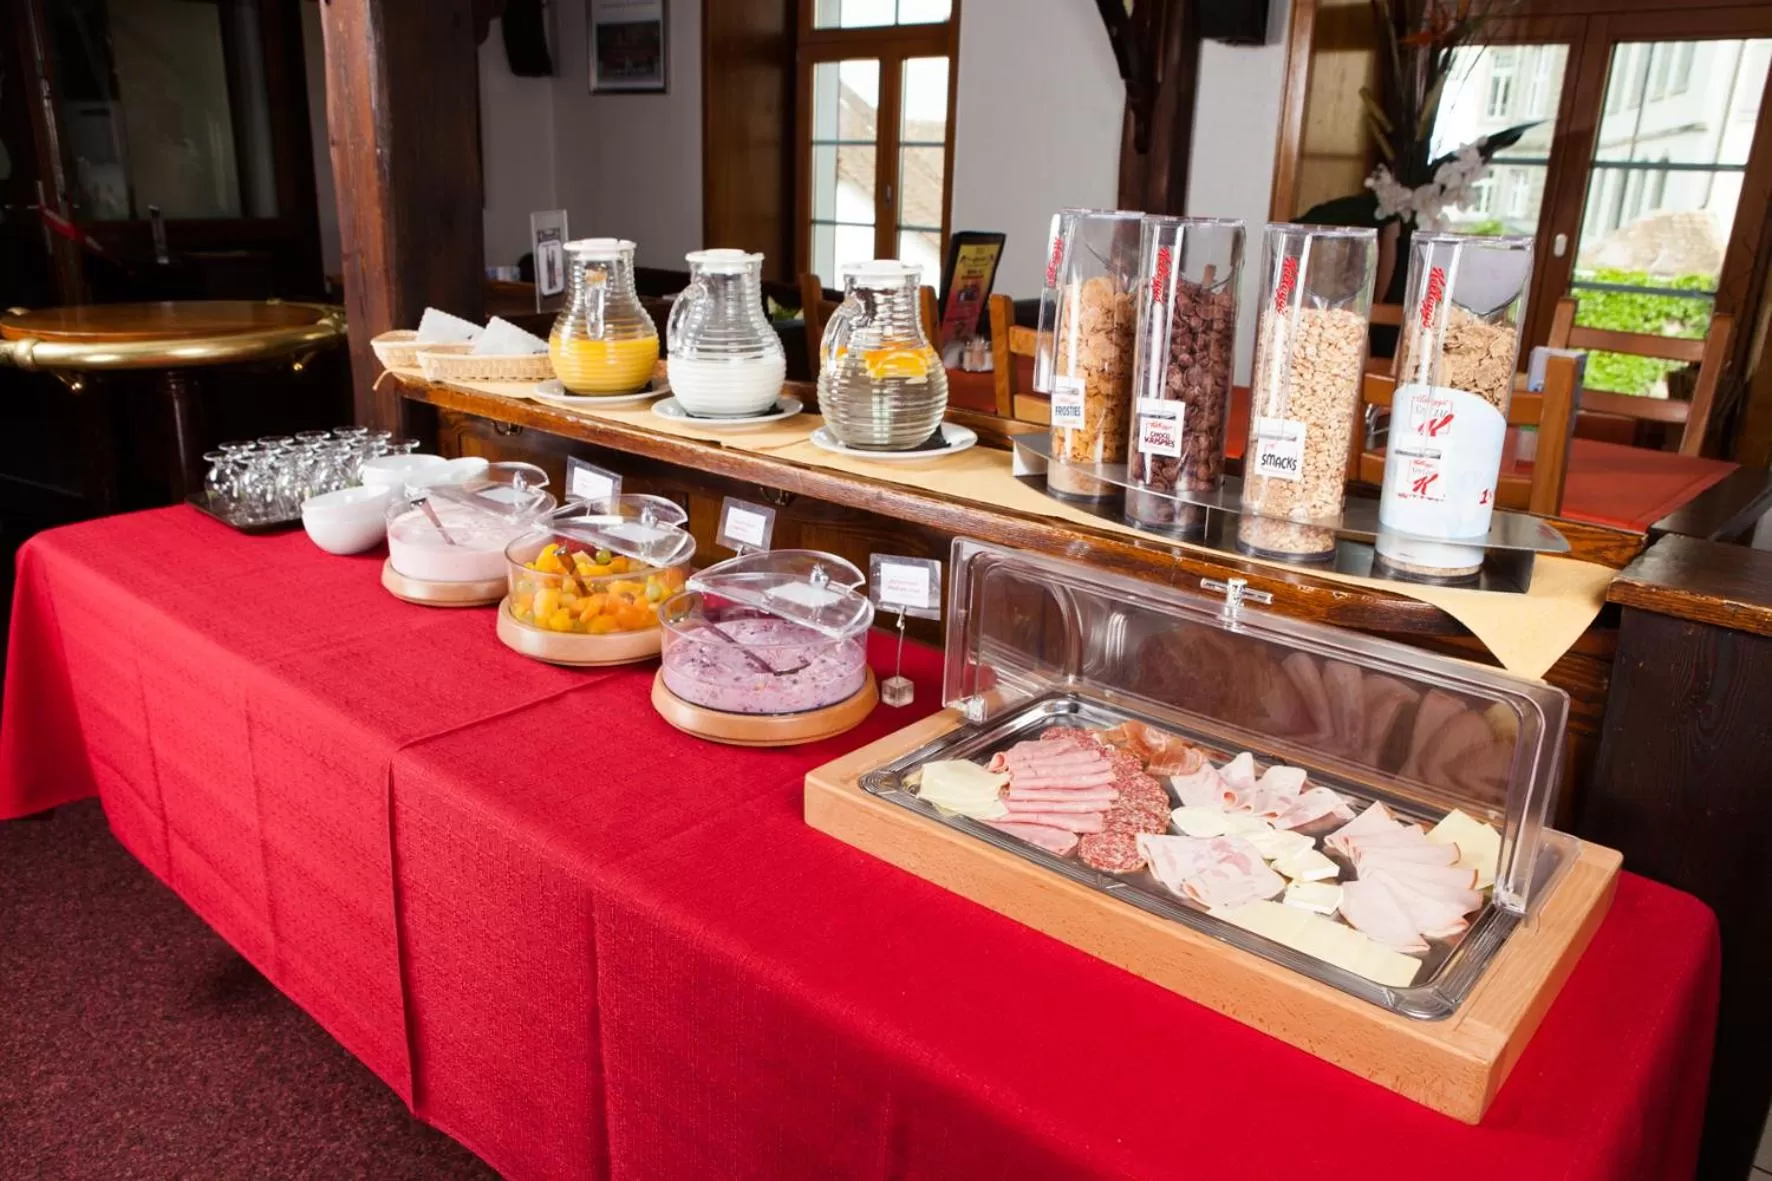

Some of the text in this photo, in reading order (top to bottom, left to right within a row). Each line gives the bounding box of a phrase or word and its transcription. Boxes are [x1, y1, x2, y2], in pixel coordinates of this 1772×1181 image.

[1275, 255, 1298, 316] Kellogg's
[1420, 265, 1448, 328] Kellogg's
[1054, 405, 1082, 417] FROSTIES
[1261, 452, 1298, 471] SMACKS
[1412, 473, 1439, 496] K
